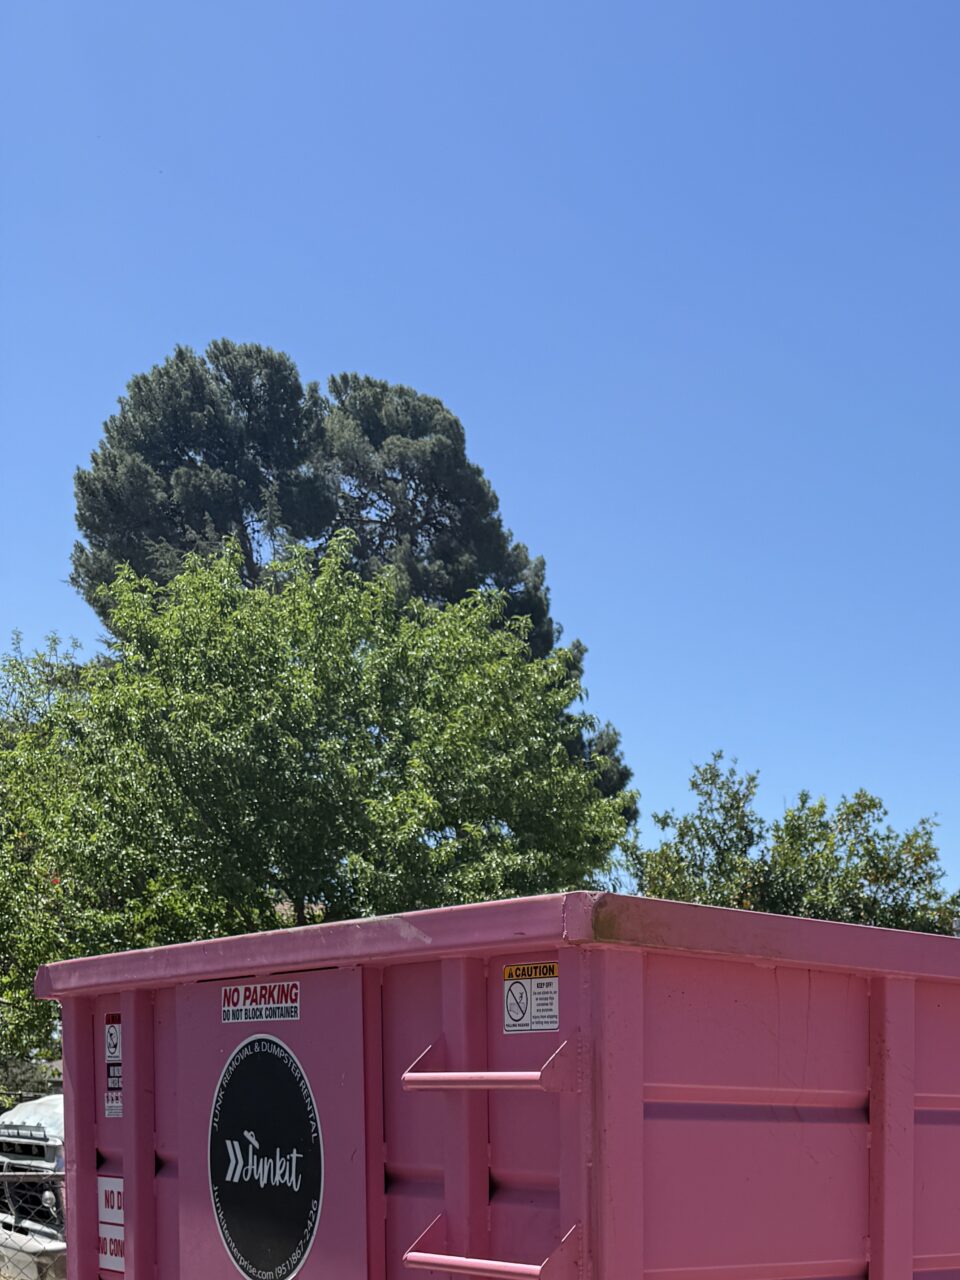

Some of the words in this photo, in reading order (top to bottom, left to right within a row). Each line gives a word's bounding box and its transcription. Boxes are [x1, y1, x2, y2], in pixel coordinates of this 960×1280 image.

[514, 965, 555, 978] CAUTION
[222, 987, 240, 1008] NO
[243, 983, 299, 1006] PARKING
[222, 1009, 231, 1021] DO
[231, 1008, 243, 1021] NOT
[244, 1007, 264, 1020] BLOCK
[265, 1005, 299, 1019] CONTAINER
[213, 1089, 225, 1132] JUNK
[222, 1045, 254, 1088] REMOVAL
[254, 1042, 261, 1052] &
[261, 1041, 301, 1081] DUMPSTER
[299, 1079, 320, 1144] RENTAL
[242, 1142, 304, 1192] Junkit
[104, 1189, 115, 1210] NO
[116, 1191, 124, 1211] D
[98, 1237, 107, 1255] NO
[109, 1238, 125, 1258] CON
[275, 1199, 318, 1279] (951)867-2426
